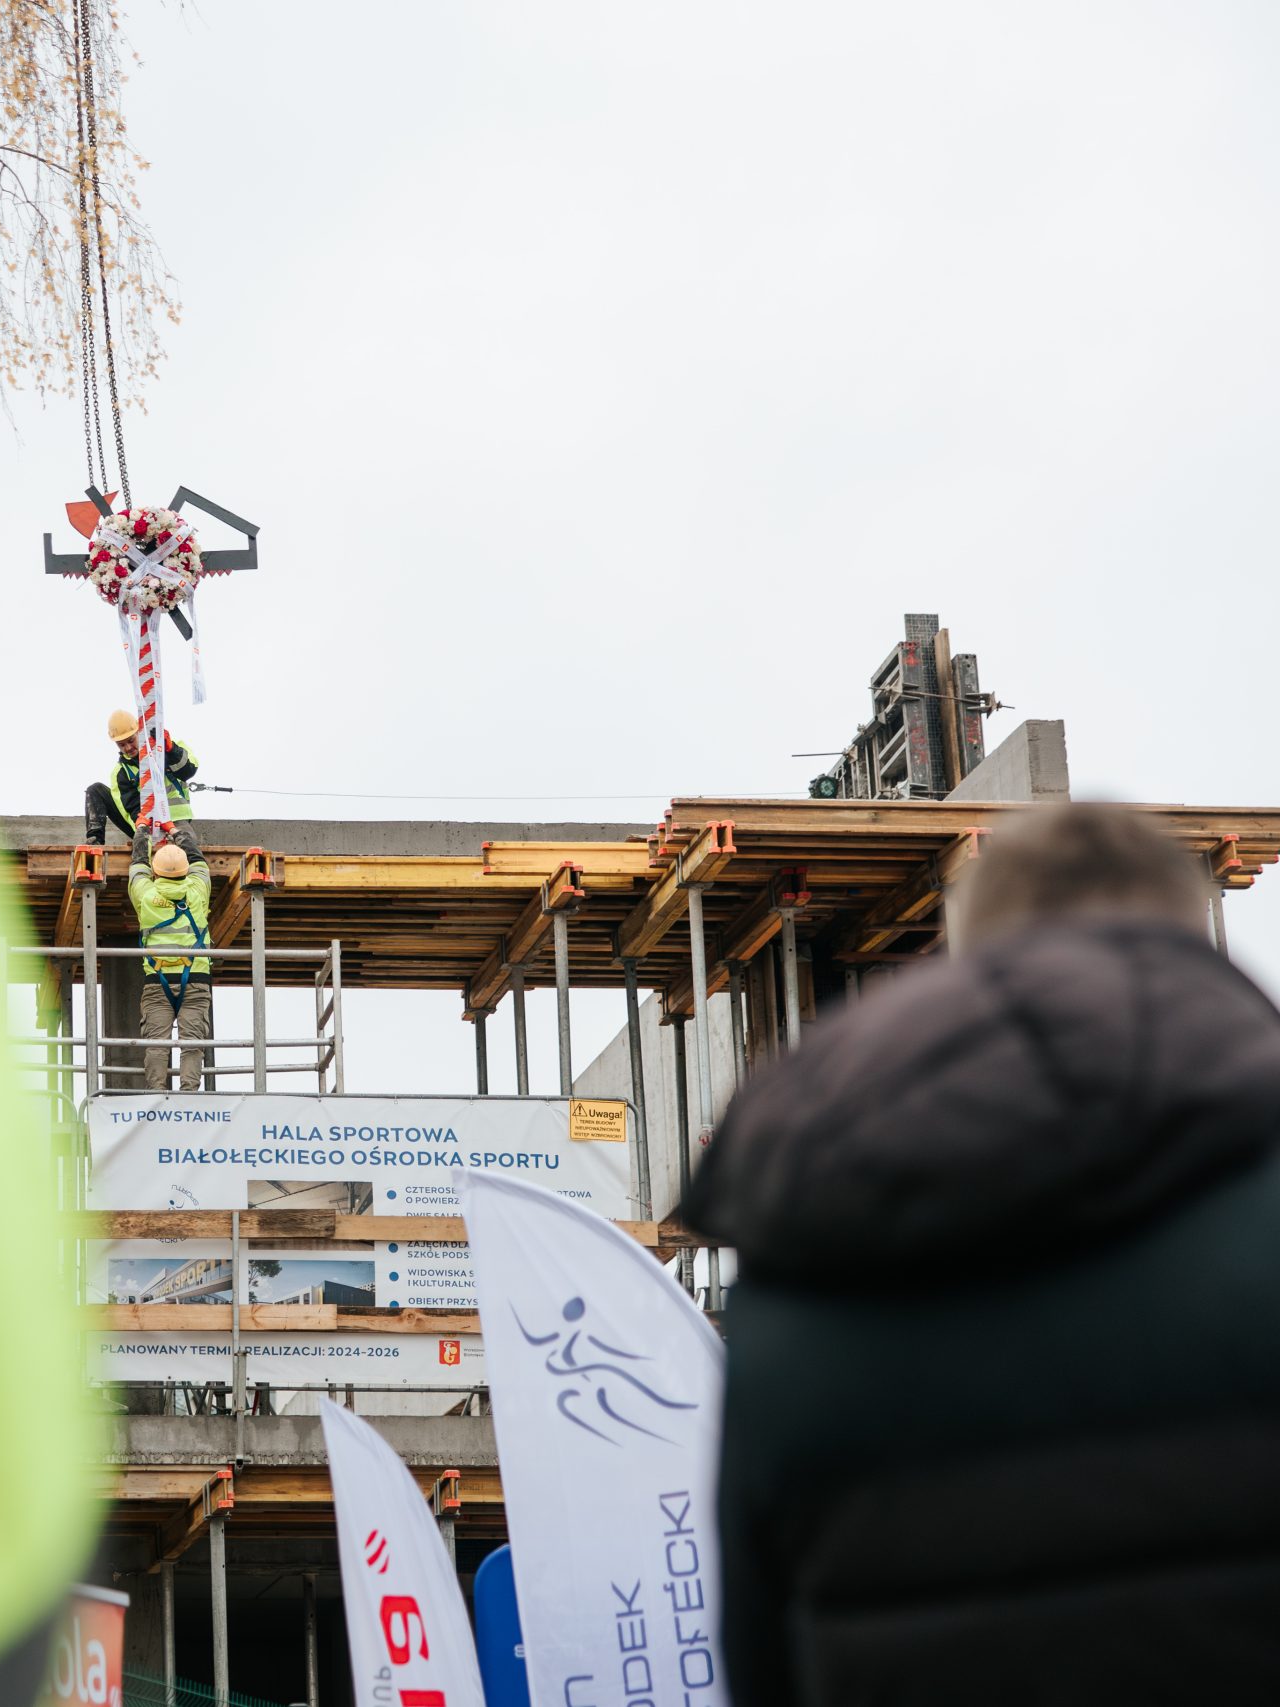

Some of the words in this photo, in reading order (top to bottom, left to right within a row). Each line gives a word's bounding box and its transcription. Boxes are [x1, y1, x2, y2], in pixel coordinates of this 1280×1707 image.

[110, 1112, 133, 1123] TU
[137, 1110, 231, 1122] POWSTANIE
[589, 1109, 622, 1120] Uwaga!
[262, 1125, 323, 1141] HALA
[329, 1126, 459, 1143] SPORTOWA
[158, 1148, 345, 1167] BIAŁOŁĘCKIEGO
[351, 1146, 464, 1167] OŚRODKA
[469, 1152, 560, 1169] SPORTU
[405, 1196, 413, 1204] O
[415, 1196, 461, 1205] POWIERZ
[407, 1250, 440, 1258] SZKÓŁ
[442, 1251, 472, 1259] PODS
[407, 1269, 467, 1277] WIDOWISKA
[408, 1297, 445, 1305] OBIEKT
[446, 1297, 479, 1306] PRZYS
[100, 1344, 187, 1355] PLANOWANY
[190, 1345, 231, 1356] TERMI
[327, 1346, 400, 1357] 2024-2026
